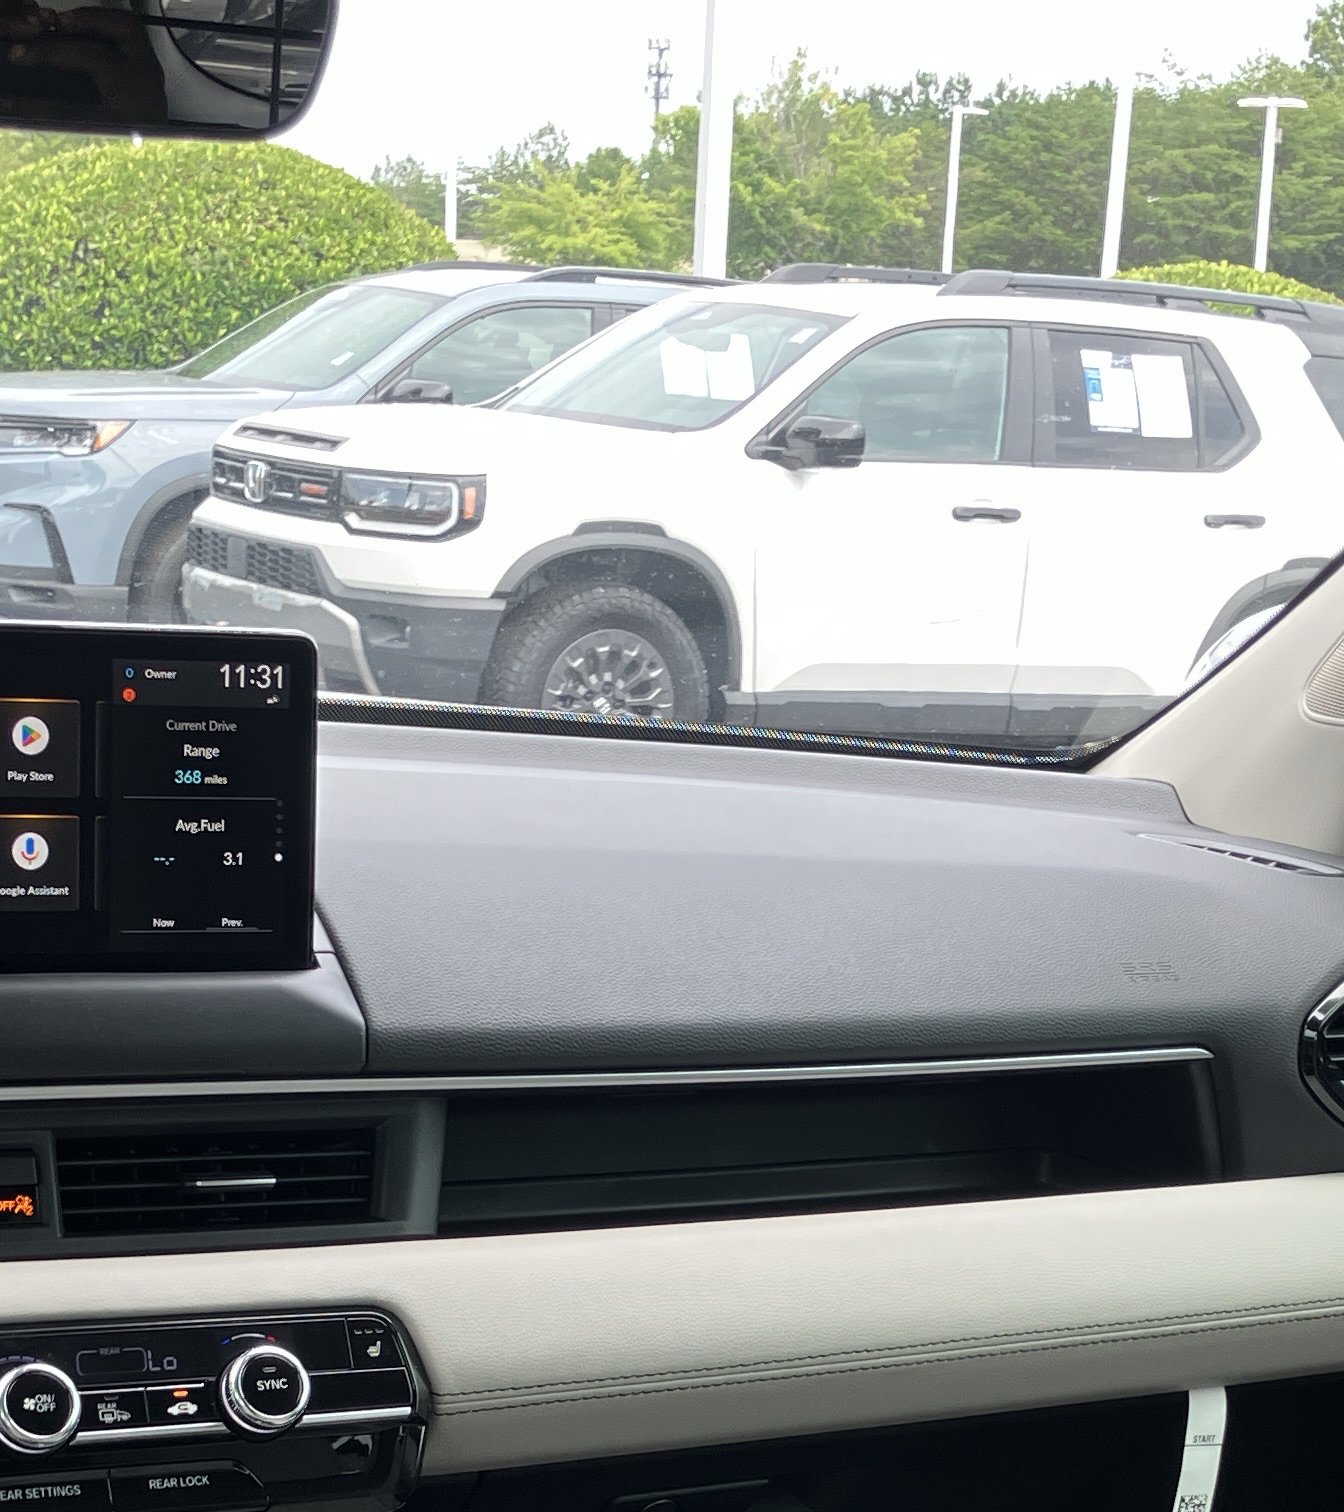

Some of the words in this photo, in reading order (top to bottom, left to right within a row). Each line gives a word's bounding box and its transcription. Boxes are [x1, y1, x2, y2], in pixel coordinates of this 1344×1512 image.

[144, 669, 177, 680] Owner
[219, 663, 283, 689] 11:31
[166, 719, 206, 731] Current
[209, 720, 237, 732] Drive
[183, 744, 220, 759] Range
[7, 771, 28, 783] Play
[29, 771, 54, 781] Store
[174, 770, 201, 784] 368
[204, 775, 227, 785] miles
[175, 818, 225, 834] Avg.Fuel
[223, 852, 243, 866] 3.1
[27, 885, 69, 896] Assistant
[152, 918, 175, 928] Now
[256, 1378, 288, 1392] SYNC
[35, 1394, 55, 1403] ON/
[36, 1403, 56, 1412] OFF
[97, 1402, 117, 1410] REAR
[1193, 1434, 1216, 1443] START
[149, 1477, 177, 1490] REAR
[180, 1475, 210, 1488] LOCK
[25, 1484, 81, 1499] SETTINGS
